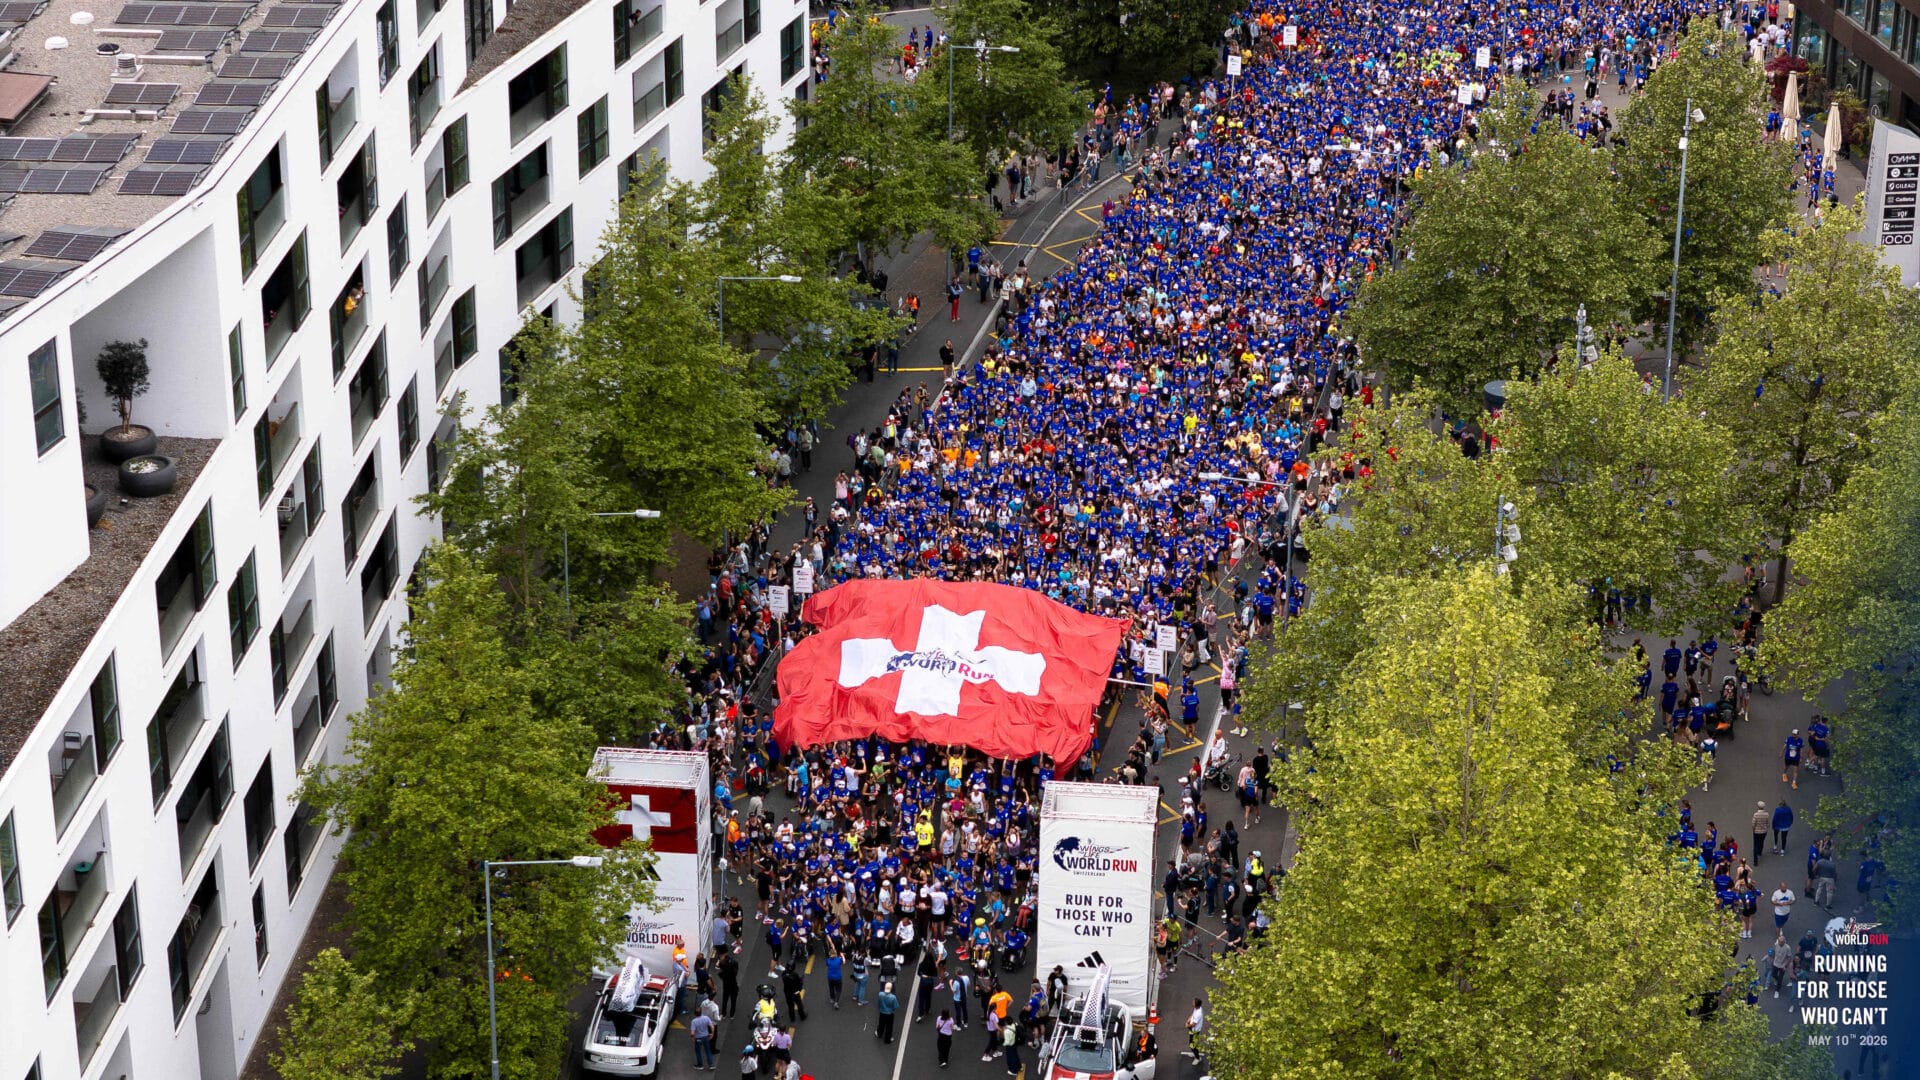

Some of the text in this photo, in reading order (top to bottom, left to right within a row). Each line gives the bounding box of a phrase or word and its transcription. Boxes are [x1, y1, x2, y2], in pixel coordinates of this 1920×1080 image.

[1067, 856, 1137, 873] WORLD RUN
[1065, 894, 1123, 908] RUN FOR
[1055, 908, 1133, 924] THOSE WHO
[1074, 923, 1114, 937] CAN'T
